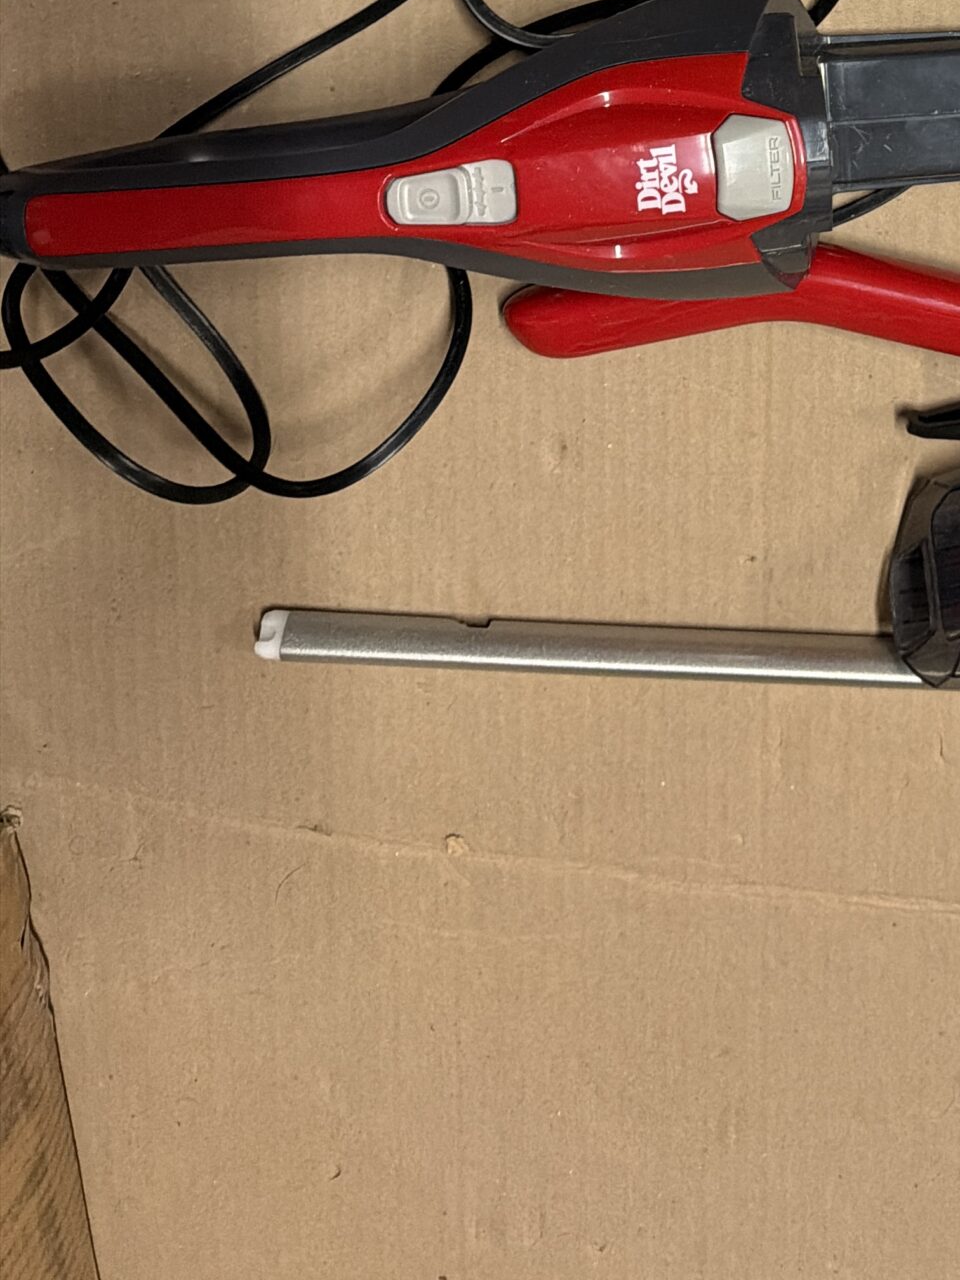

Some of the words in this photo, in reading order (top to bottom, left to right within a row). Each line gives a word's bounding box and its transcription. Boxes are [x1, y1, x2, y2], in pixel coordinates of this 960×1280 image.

[635, 158, 662, 211] Dirt
[650, 144, 686, 215] Devil
[769, 137, 782, 201] FILTER
